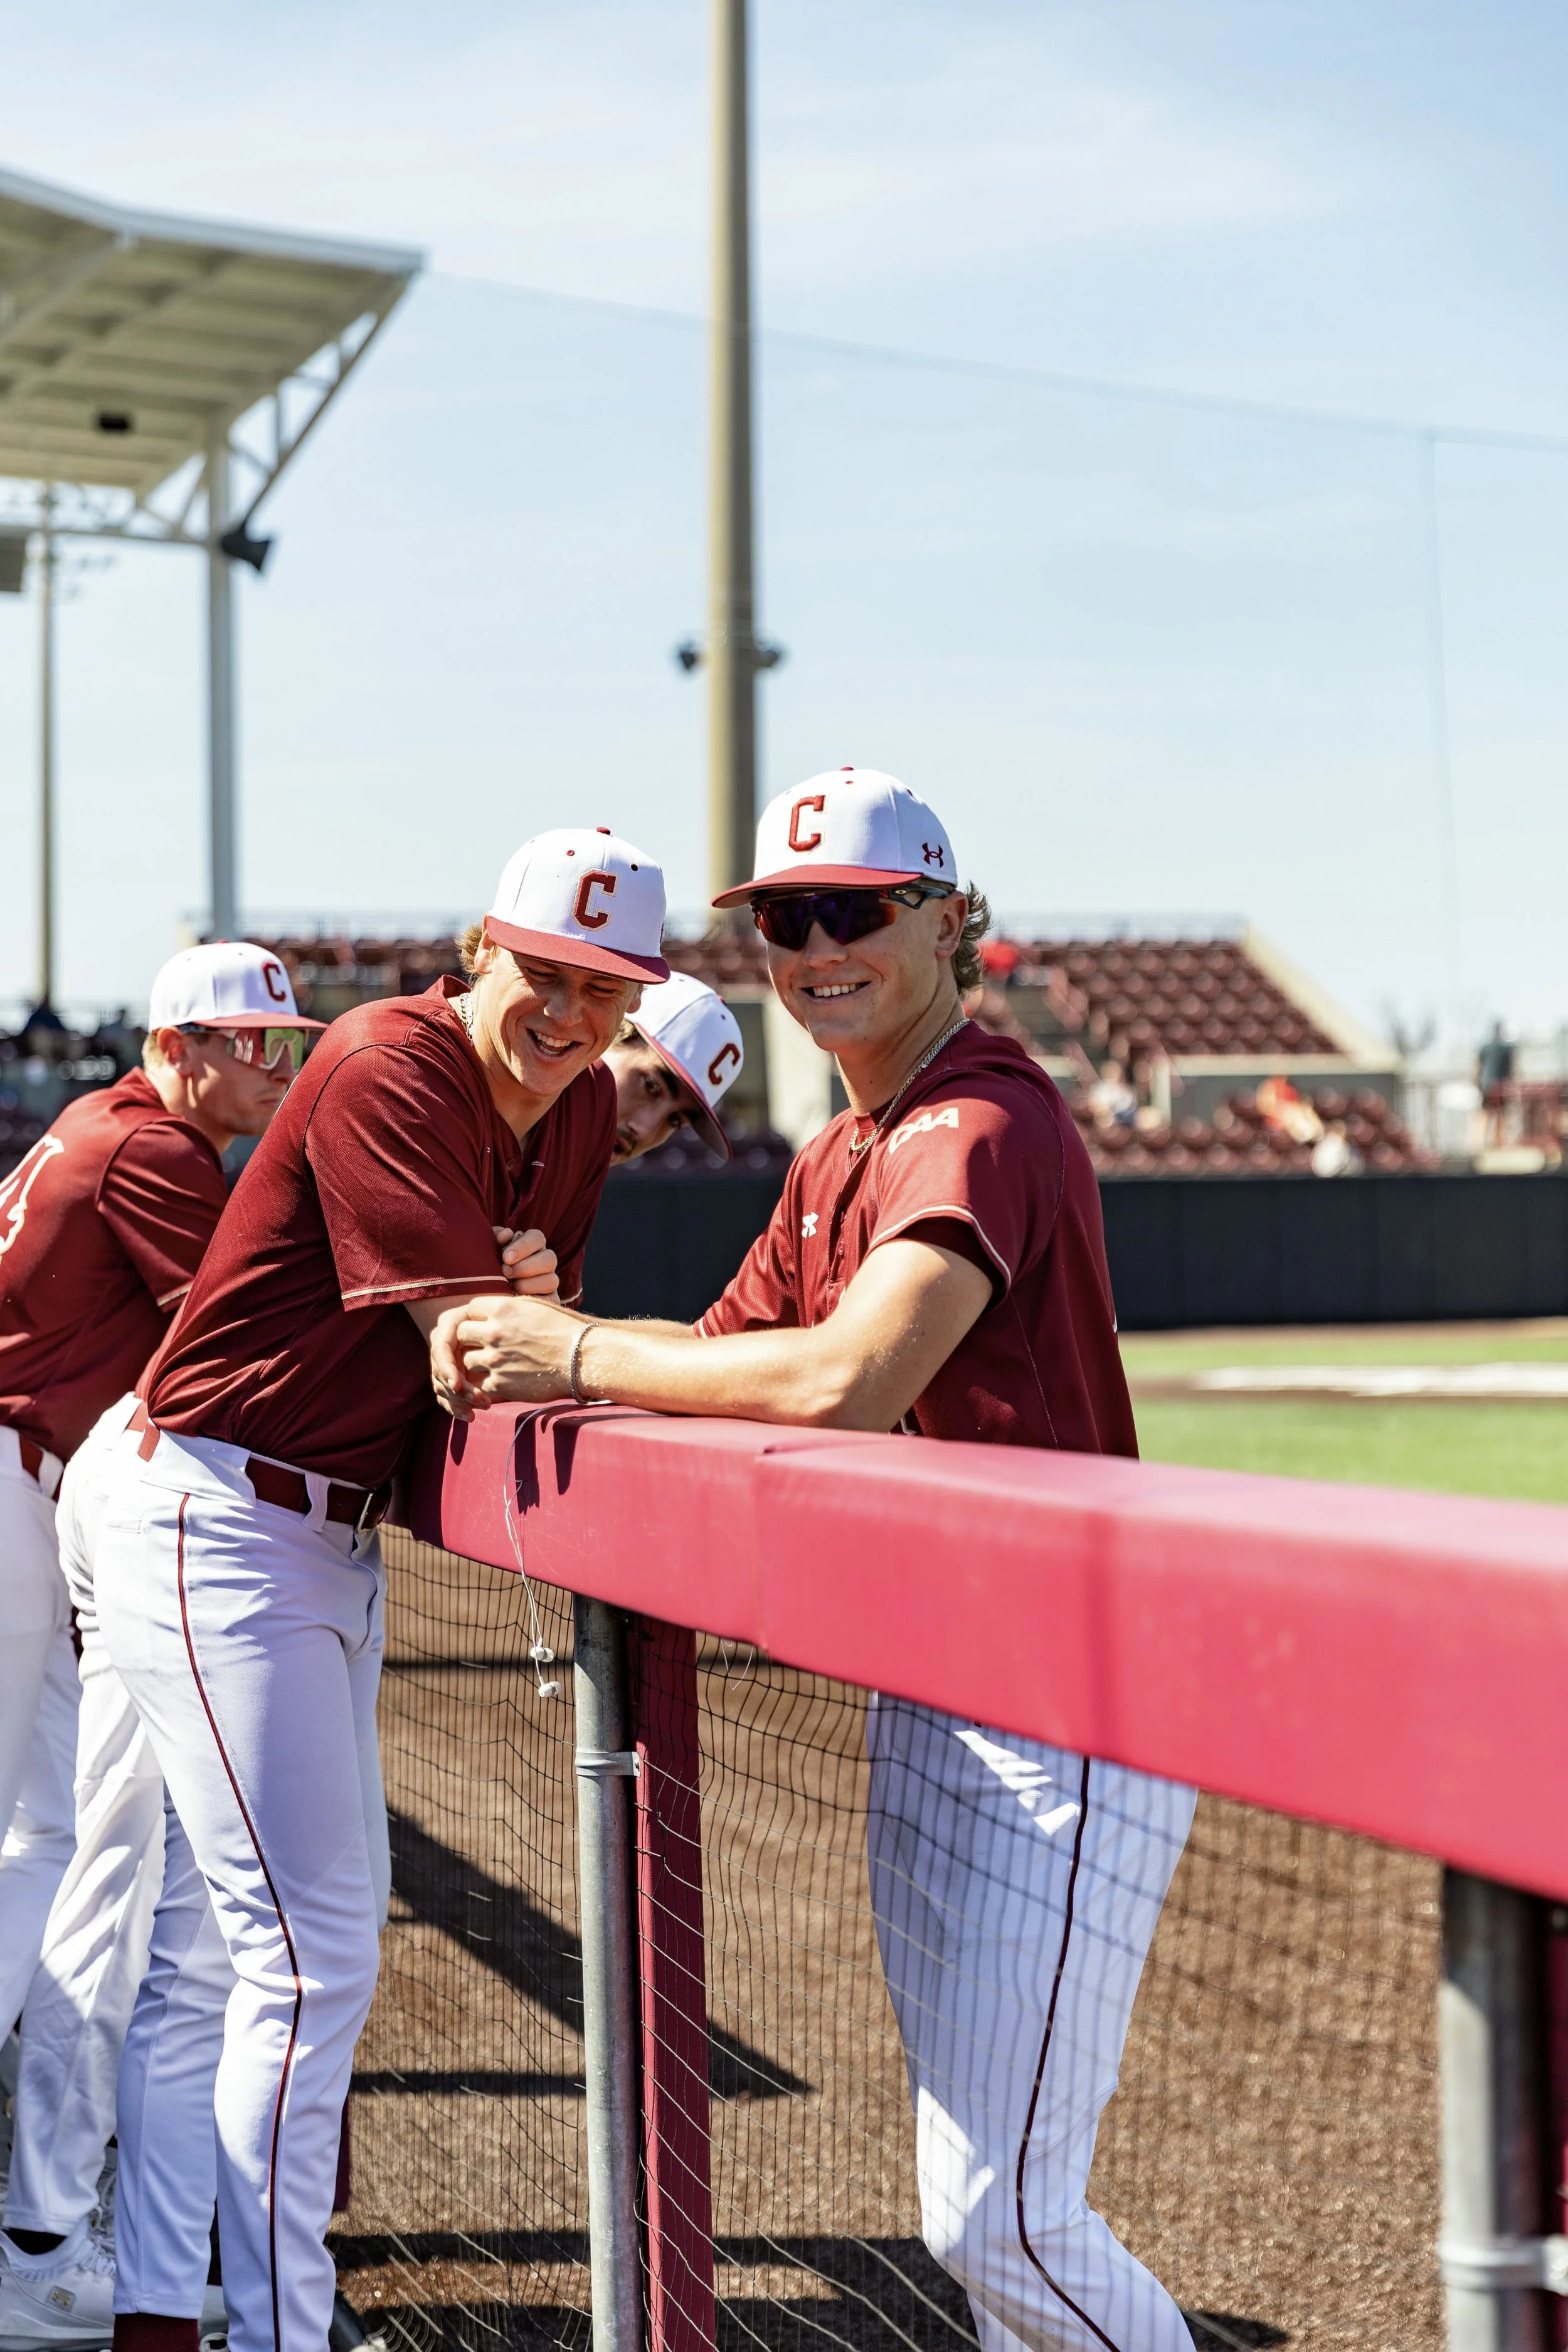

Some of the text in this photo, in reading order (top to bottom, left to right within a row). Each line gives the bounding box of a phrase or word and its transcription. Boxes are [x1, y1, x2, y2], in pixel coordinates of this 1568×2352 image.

[787, 794, 827, 854] C
[572, 868, 620, 931] C
[262, 961, 287, 1002] C
[707, 1042, 741, 1086] C
